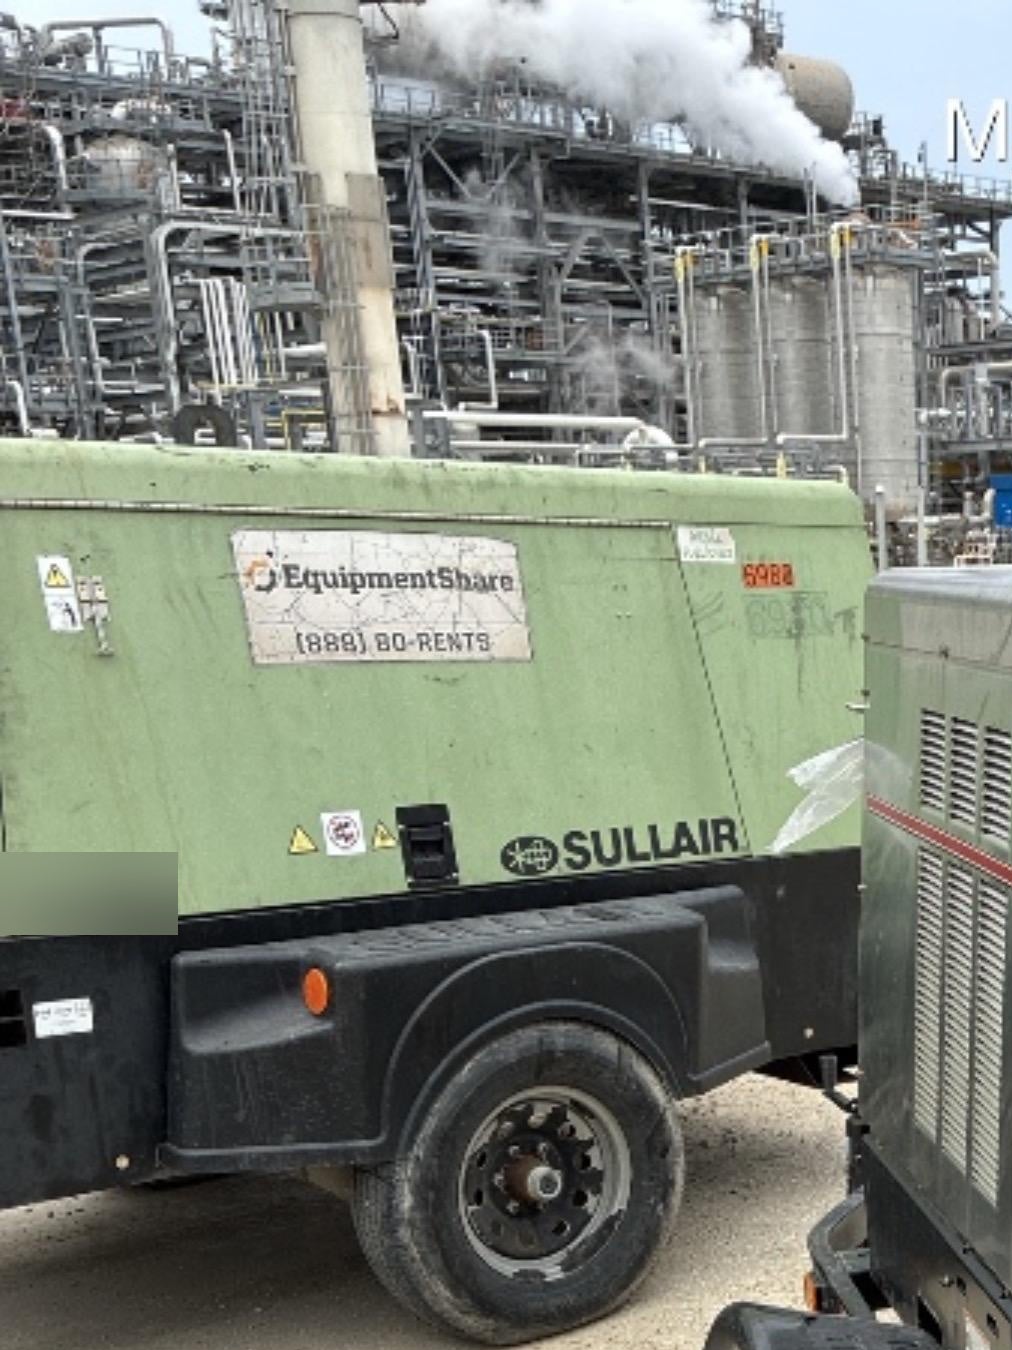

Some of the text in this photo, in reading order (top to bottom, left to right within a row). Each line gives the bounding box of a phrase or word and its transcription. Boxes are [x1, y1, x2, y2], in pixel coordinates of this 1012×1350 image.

[281, 564, 514, 594] EquipmentShare
[296, 633, 367, 654] (888)
[563, 818, 739, 871] SULLAIR
